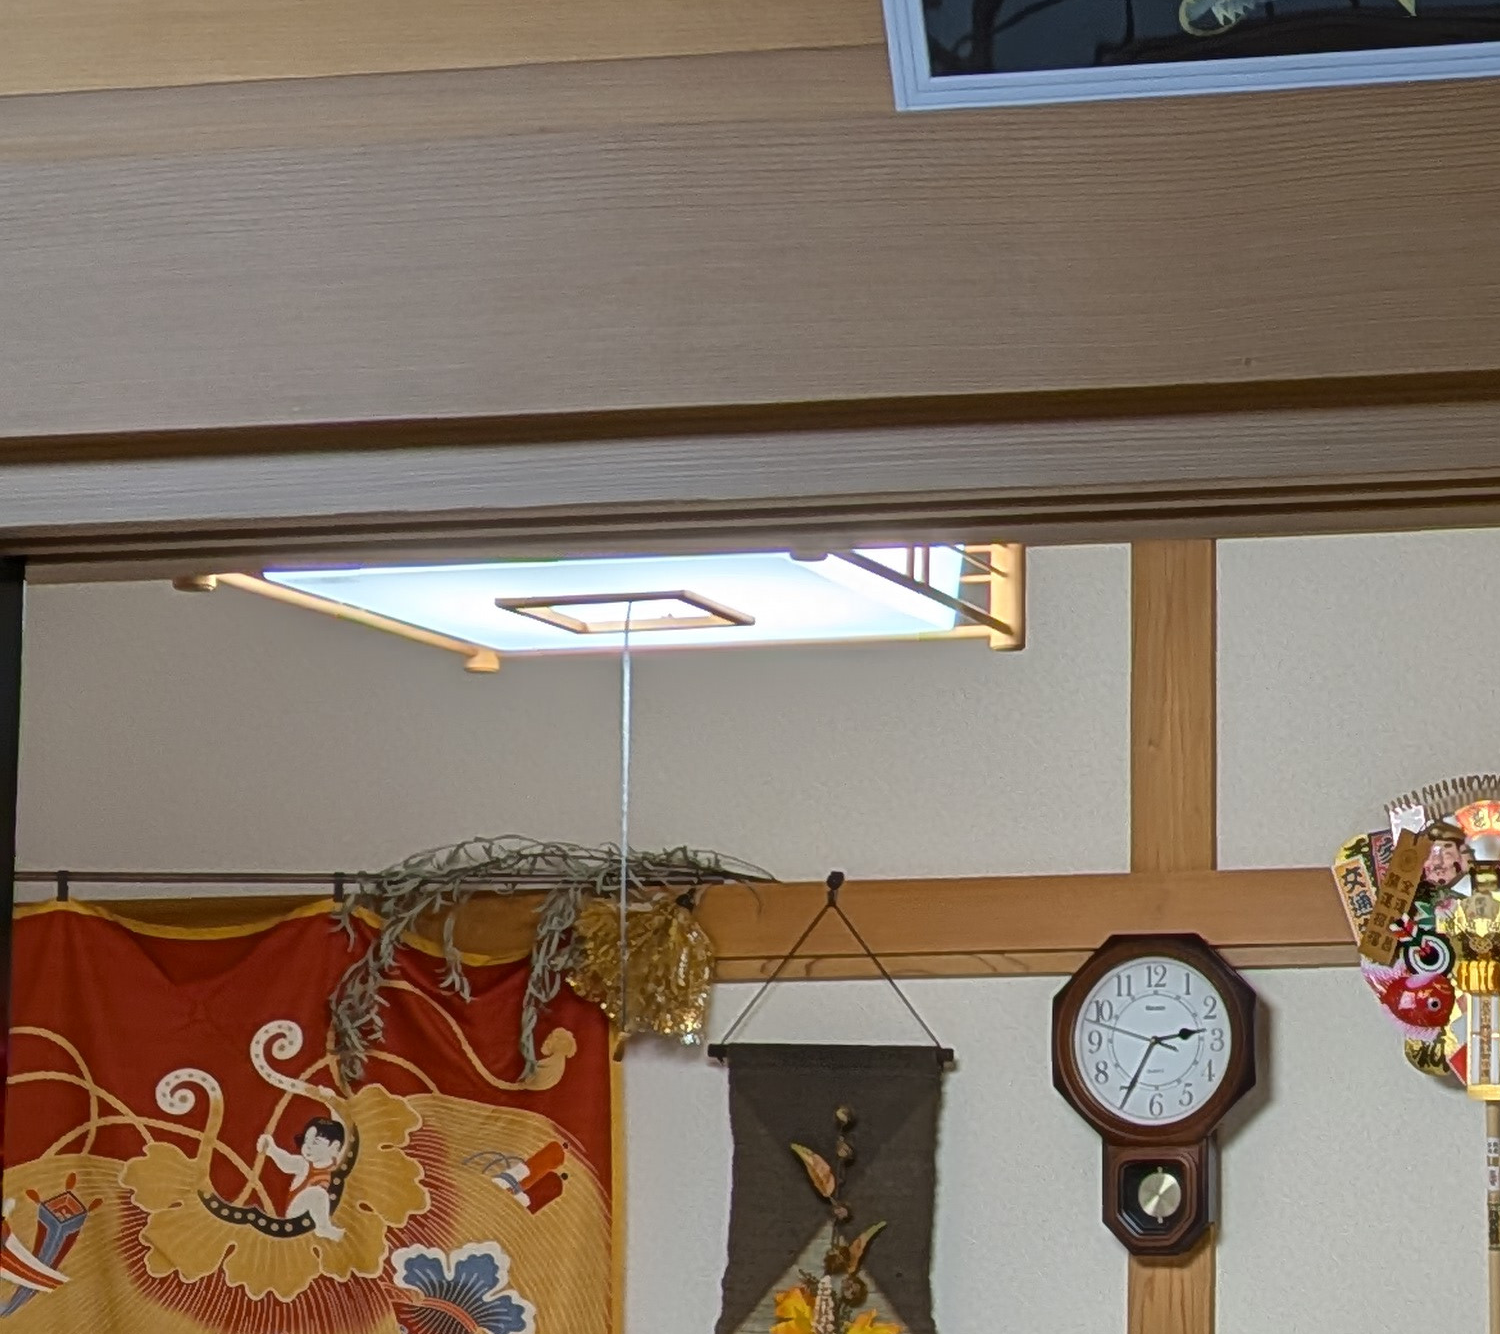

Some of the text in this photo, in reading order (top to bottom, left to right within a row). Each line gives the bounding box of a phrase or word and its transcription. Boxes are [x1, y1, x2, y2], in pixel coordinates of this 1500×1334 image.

[1116, 973, 1132, 997] 11
[1146, 964, 1167, 988] 12
[1185, 973, 1191, 995] 1
[1092, 999, 1113, 1023] 10
[1203, 996, 1217, 1019] 2
[1088, 1030, 1102, 1054] 9
[1210, 1028, 1224, 1052] 3
[1094, 1060, 1109, 1084] 8
[1201, 1059, 1215, 1082] 4
[1149, 1093, 1163, 1117] 6
[1178, 1083, 1193, 1107] 5
